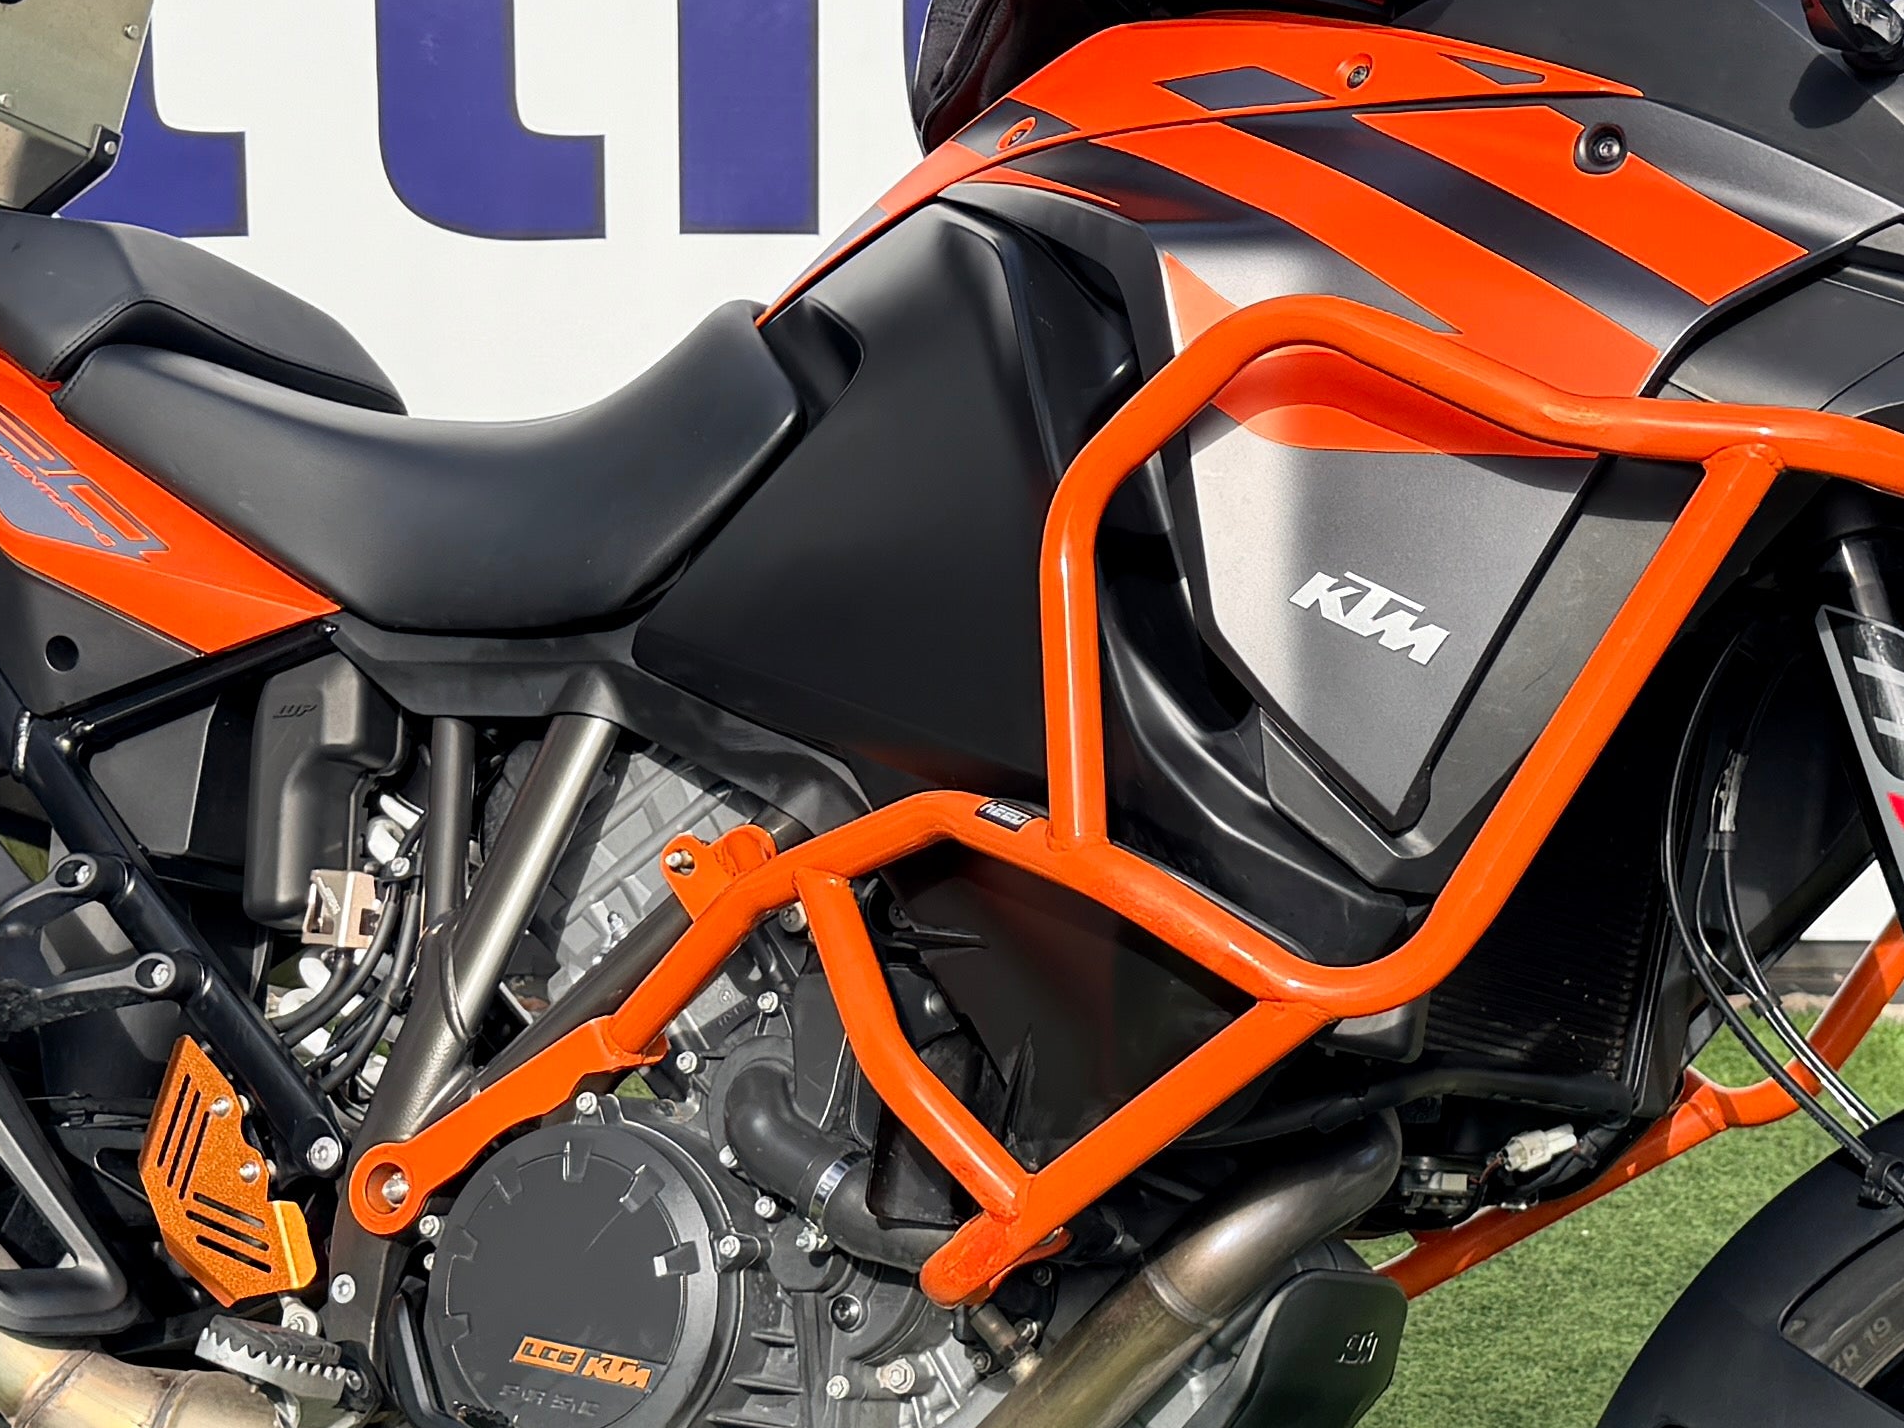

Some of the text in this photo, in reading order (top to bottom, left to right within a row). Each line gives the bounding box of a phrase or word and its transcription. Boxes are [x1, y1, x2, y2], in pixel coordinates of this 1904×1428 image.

[1288, 570, 1452, 667] KTM
[1862, 1315, 1893, 1346] 19
[580, 1351, 653, 1392] KTM
